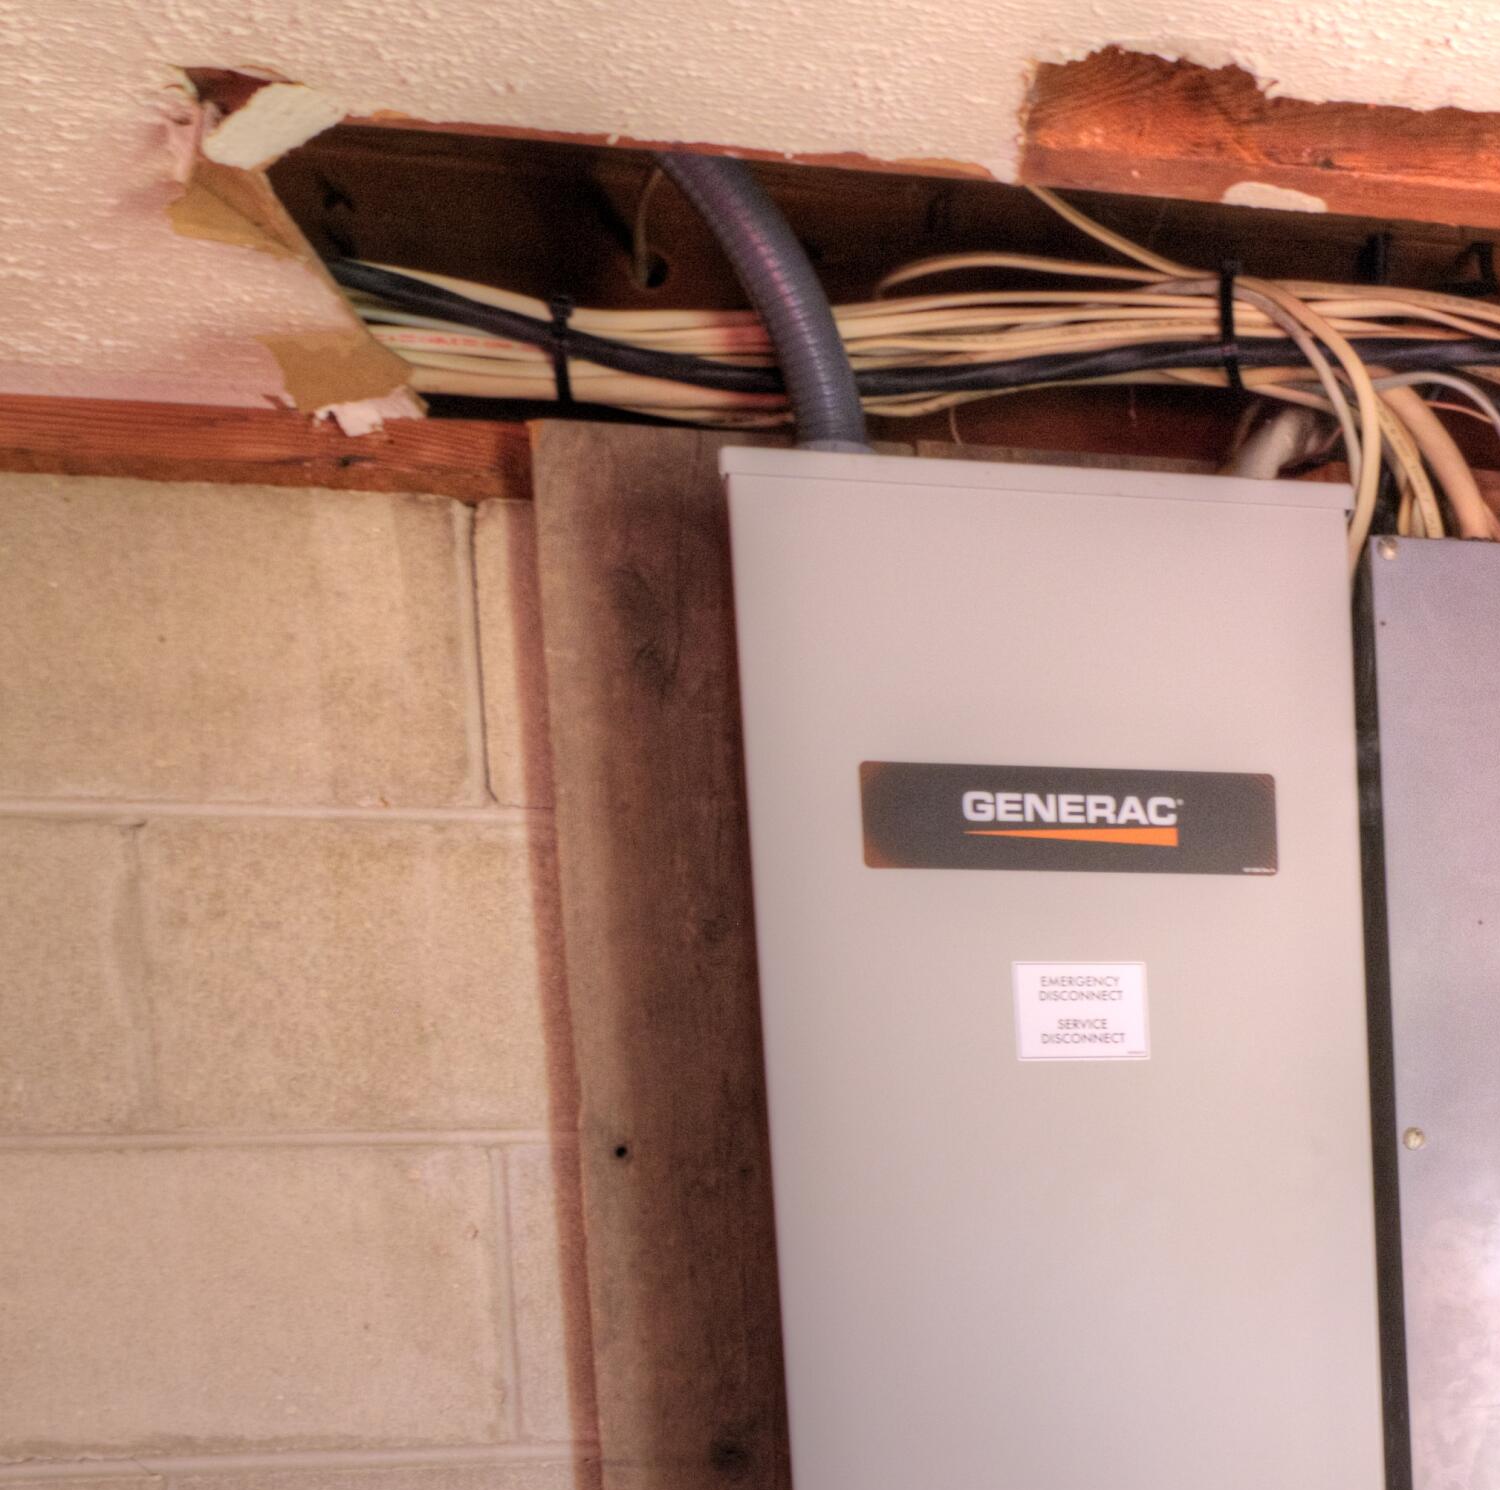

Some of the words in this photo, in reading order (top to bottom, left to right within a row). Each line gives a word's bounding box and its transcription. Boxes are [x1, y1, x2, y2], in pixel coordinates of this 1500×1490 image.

[962, 790, 1178, 826] GENERAC
[1040, 976, 1120, 987] EMERGENCY
[1038, 990, 1124, 1001] DISCONNECT
[1057, 1018, 1108, 1030] SERVICE
[1040, 1033, 1126, 1044] DISCONNECT
